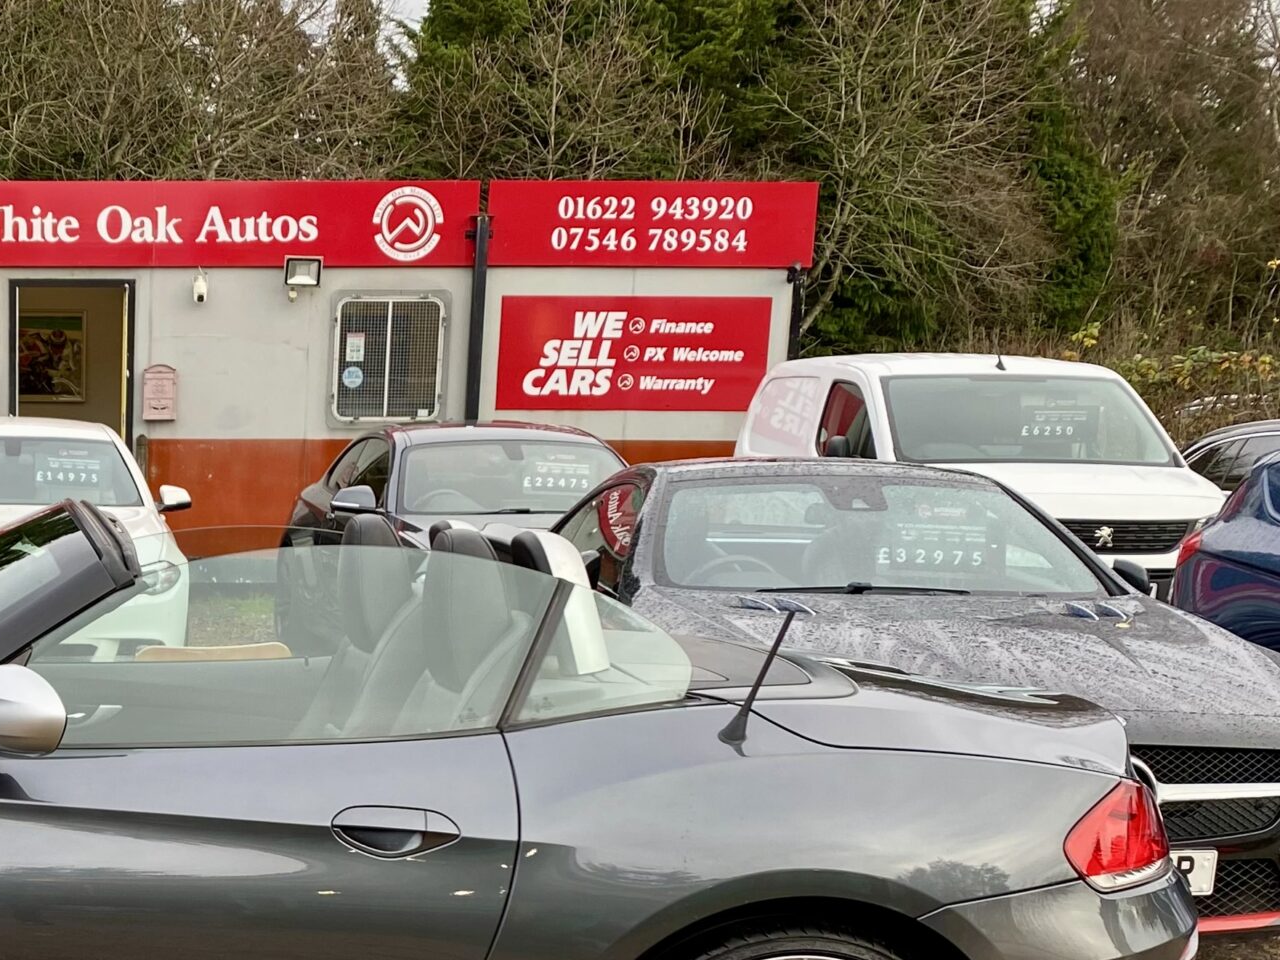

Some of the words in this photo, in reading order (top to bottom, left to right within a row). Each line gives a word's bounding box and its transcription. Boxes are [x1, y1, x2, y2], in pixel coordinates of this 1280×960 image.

[558, 196, 635, 220] 01622
[651, 196, 753, 220] 943920
[96, 204, 183, 244] Oak
[195, 206, 319, 243] Autos
[551, 227, 637, 251] 07546
[648, 228, 748, 252] 789584
[573, 311, 628, 338] WE
[649, 318, 714, 334] Finance
[539, 339, 616, 367] SELL
[643, 347, 667, 362] PX
[672, 347, 745, 362] Welcome
[522, 368, 613, 396] CARS
[639, 375, 715, 395] Warranty
[1021, 425, 1074, 436] £6250
[36, 471, 98, 483] £14975
[523, 476, 588, 489] £22475
[877, 547, 983, 566] £32975
